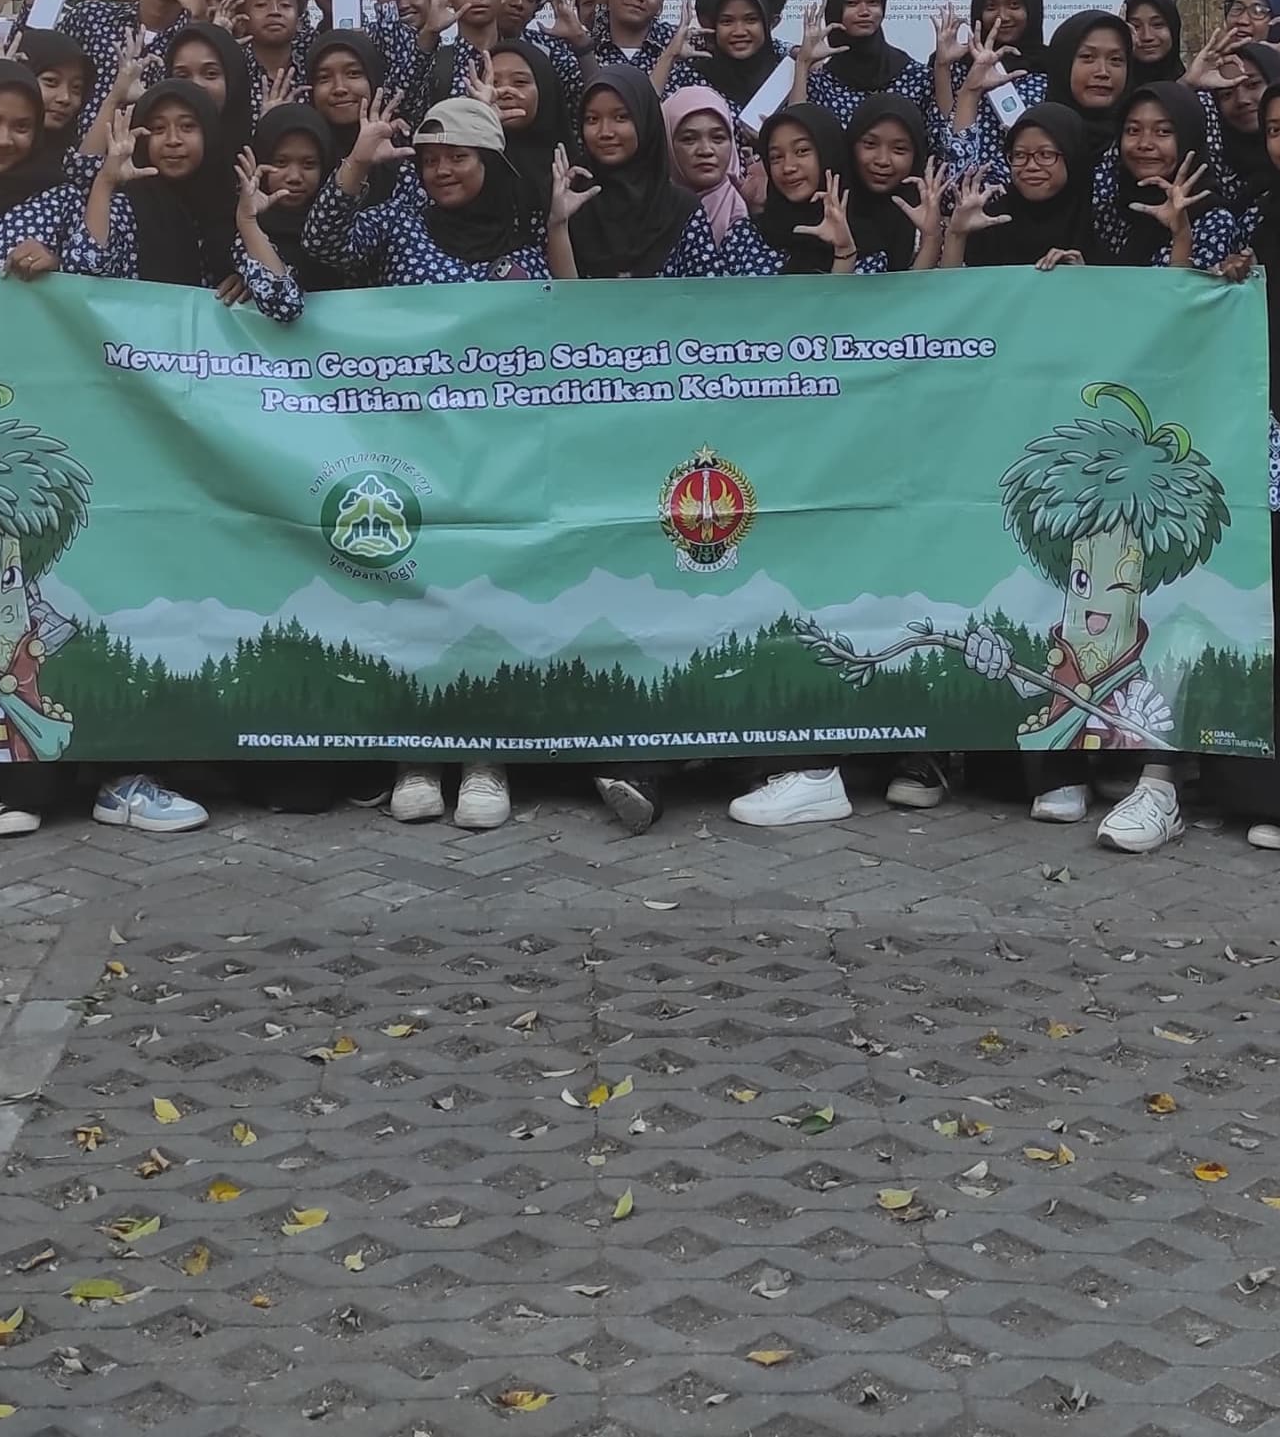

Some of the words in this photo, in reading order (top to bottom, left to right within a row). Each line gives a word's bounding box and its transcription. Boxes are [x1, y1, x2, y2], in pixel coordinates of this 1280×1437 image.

[104, 343, 312, 380] Mewujudkan
[318, 352, 452, 381] Geopark
[459, 348, 545, 377] Jogja
[551, 342, 670, 371] Sebagai
[676, 340, 783, 364] Centre
[788, 336, 825, 361] Of
[831, 334, 997, 360] Excellence
[261, 388, 421, 413] Penelitian
[427, 385, 487, 409] dan
[493, 379, 674, 407] Pendidikan
[679, 374, 840, 401] Kebumian
[238, 733, 320, 747] PROGRAM
[323, 735, 493, 749] PENYELENGGARAAN
[495, 735, 623, 750] KEISTIMEWAAN
[626, 732, 739, 747] YOGYAKARTA
[742, 728, 811, 743] URUSAN
[813, 726, 927, 741] KEBUDAYAAN
